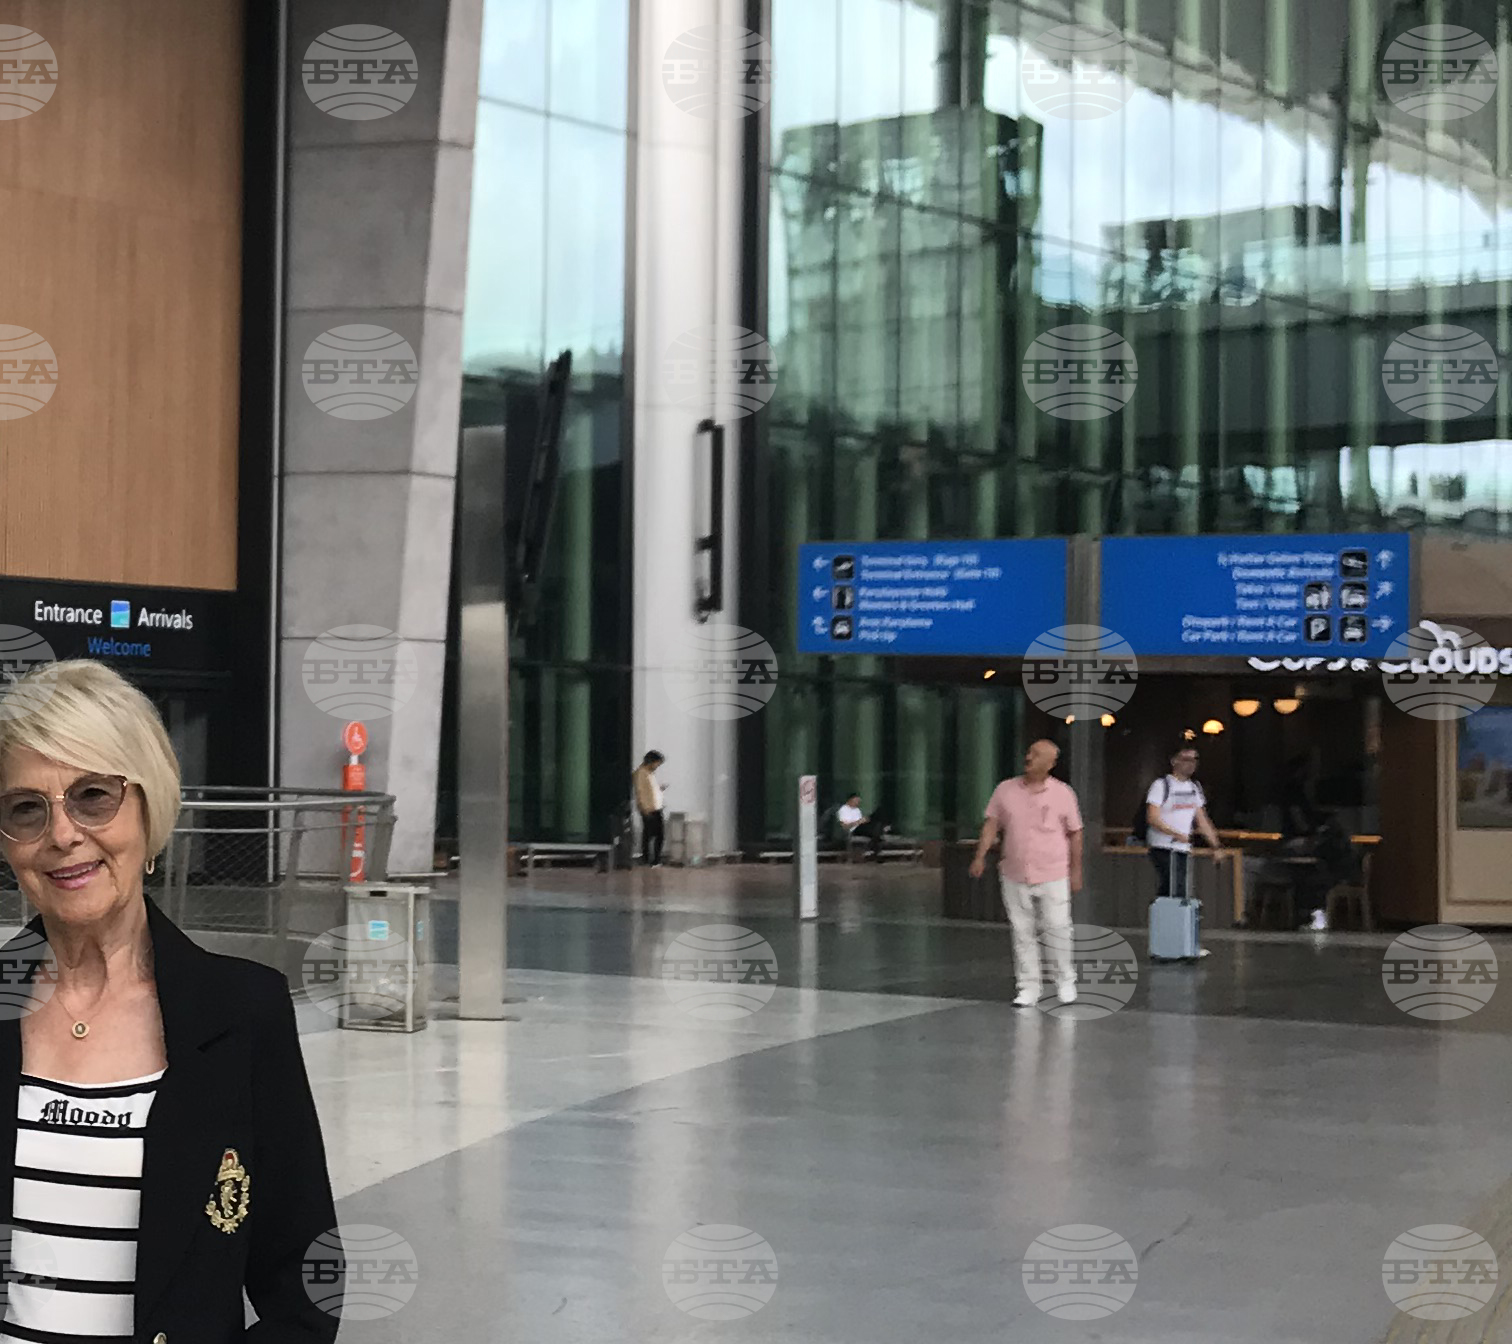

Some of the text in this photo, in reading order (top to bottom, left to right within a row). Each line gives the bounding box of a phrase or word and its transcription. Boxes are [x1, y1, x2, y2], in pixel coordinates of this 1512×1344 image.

[34, 600, 193, 630] Entrance Arrivals
[88, 637, 152, 656] Welcome
[39, 1099, 132, 1129] Moody
